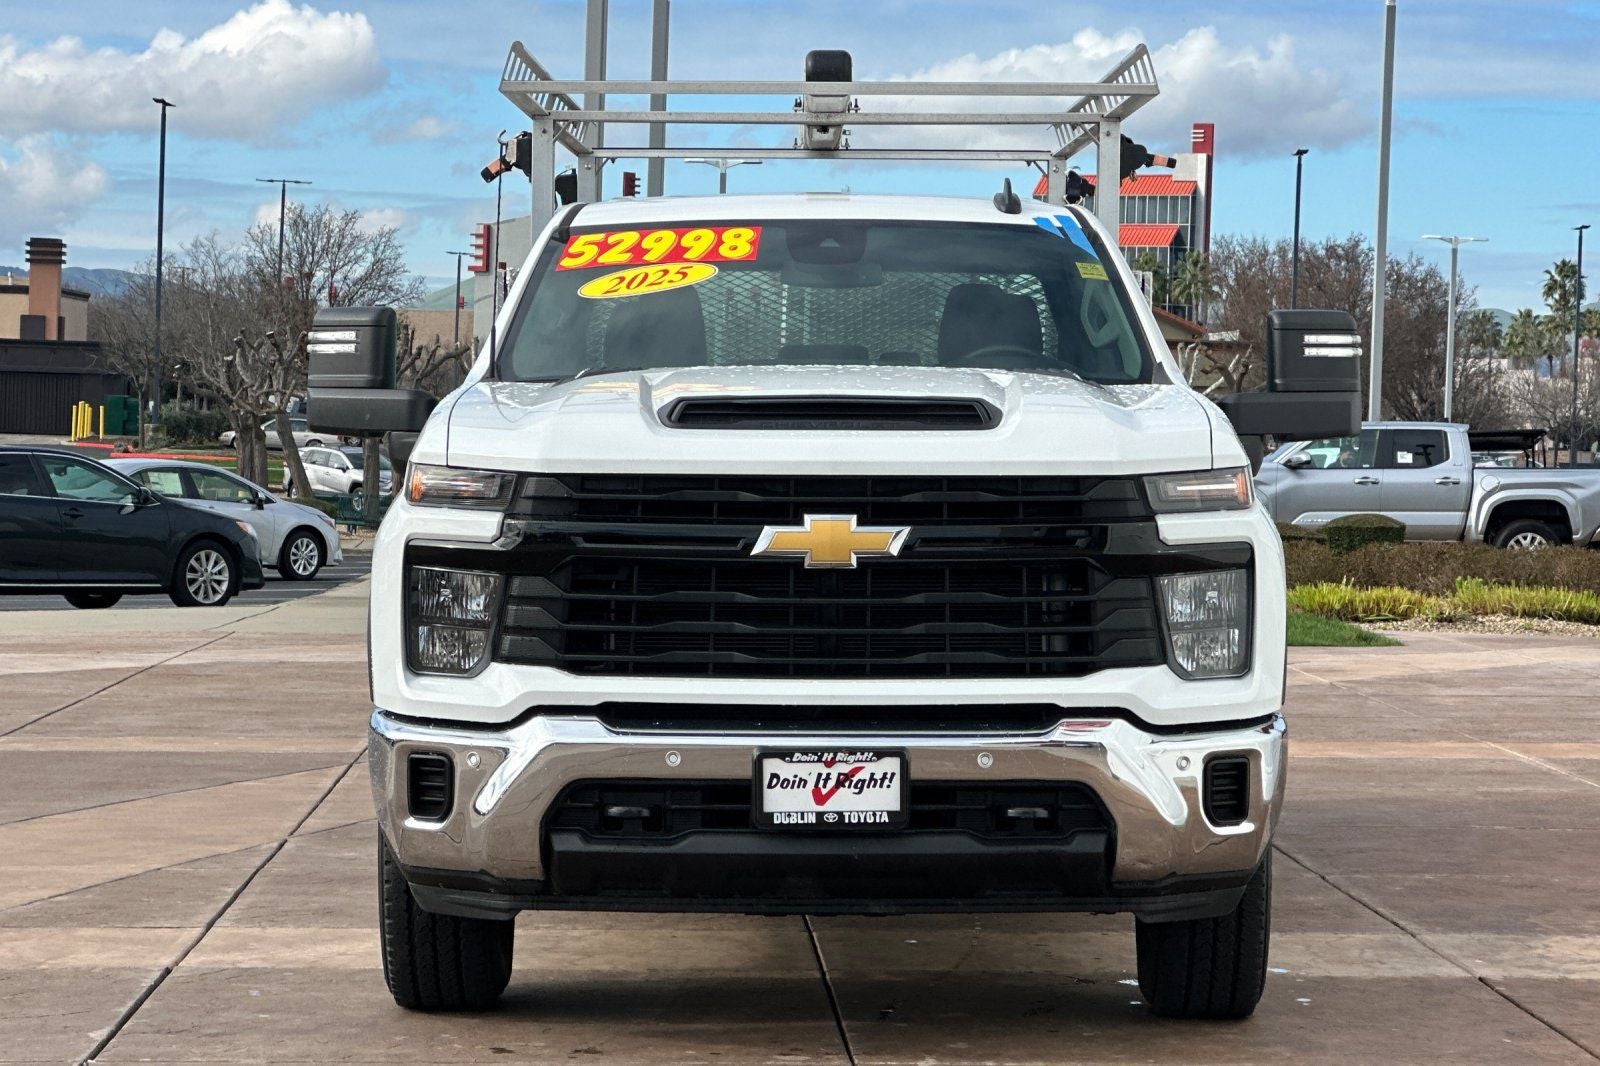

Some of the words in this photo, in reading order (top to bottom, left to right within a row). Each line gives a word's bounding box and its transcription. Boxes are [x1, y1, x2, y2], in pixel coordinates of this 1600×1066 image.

[559, 227, 757, 269] 52998
[601, 265, 695, 295] 2025
[792, 752, 820, 762] Doin'
[822, 752, 835, 762] It
[835, 752, 873, 765] Right!
[766, 772, 812, 790] Doin'
[814, 772, 832, 789] It
[835, 772, 896, 795] Right!
[773, 812, 817, 824] DUBLIN
[843, 812, 889, 823] TOYOTA
